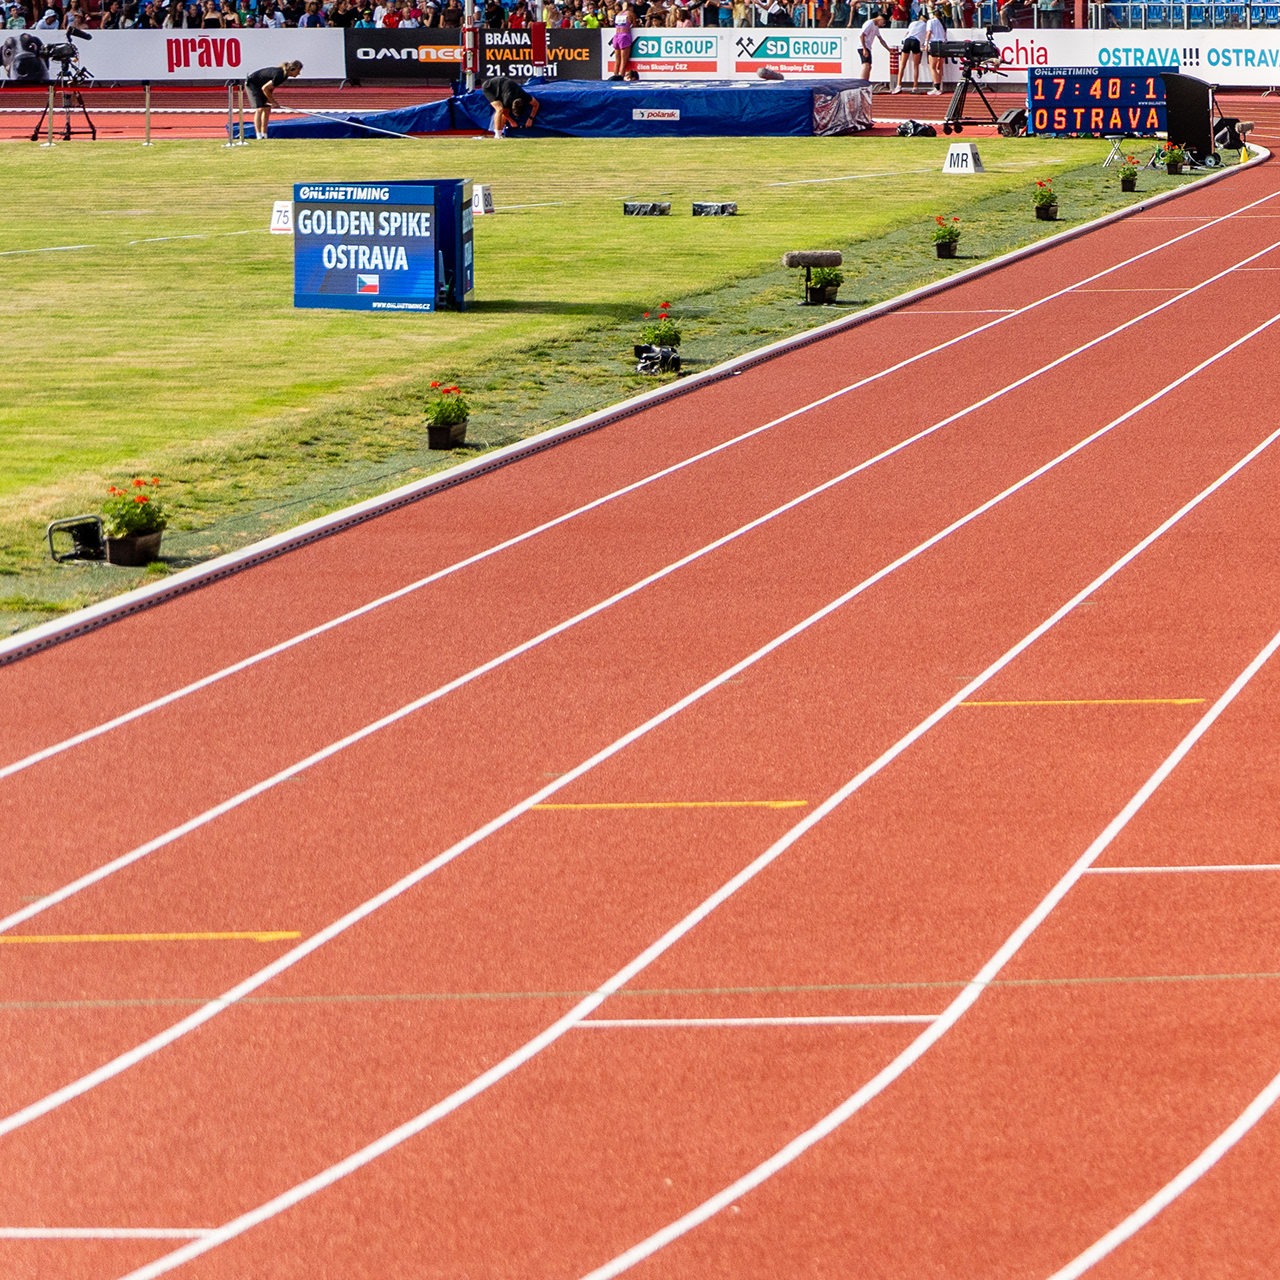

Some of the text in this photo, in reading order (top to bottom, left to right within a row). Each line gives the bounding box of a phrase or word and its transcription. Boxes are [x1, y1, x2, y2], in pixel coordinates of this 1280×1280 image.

[485, 31, 531, 45] BRÁNA
[486, 46, 590, 61] KVALIT VÝUCE
[638, 39, 714, 55] SD GROUP
[766, 40, 838, 56] SD GROUP
[1098, 47, 1200, 67] OSTRAVA!!!
[486, 64, 506, 77] 21.
[637, 62, 688, 72] člen Skupiny ČEZ
[778, 64, 802, 73] Skupiny
[802, 62, 815, 72] ČEZ
[1035, 108, 1159, 130] OSTRAVA
[949, 152, 969, 169] MR
[276, 209, 290, 225] 75
[298, 209, 375, 235] GOLDEN
[378, 211, 431, 237] SPIKE
[322, 243, 409, 271] OSTRAVA
